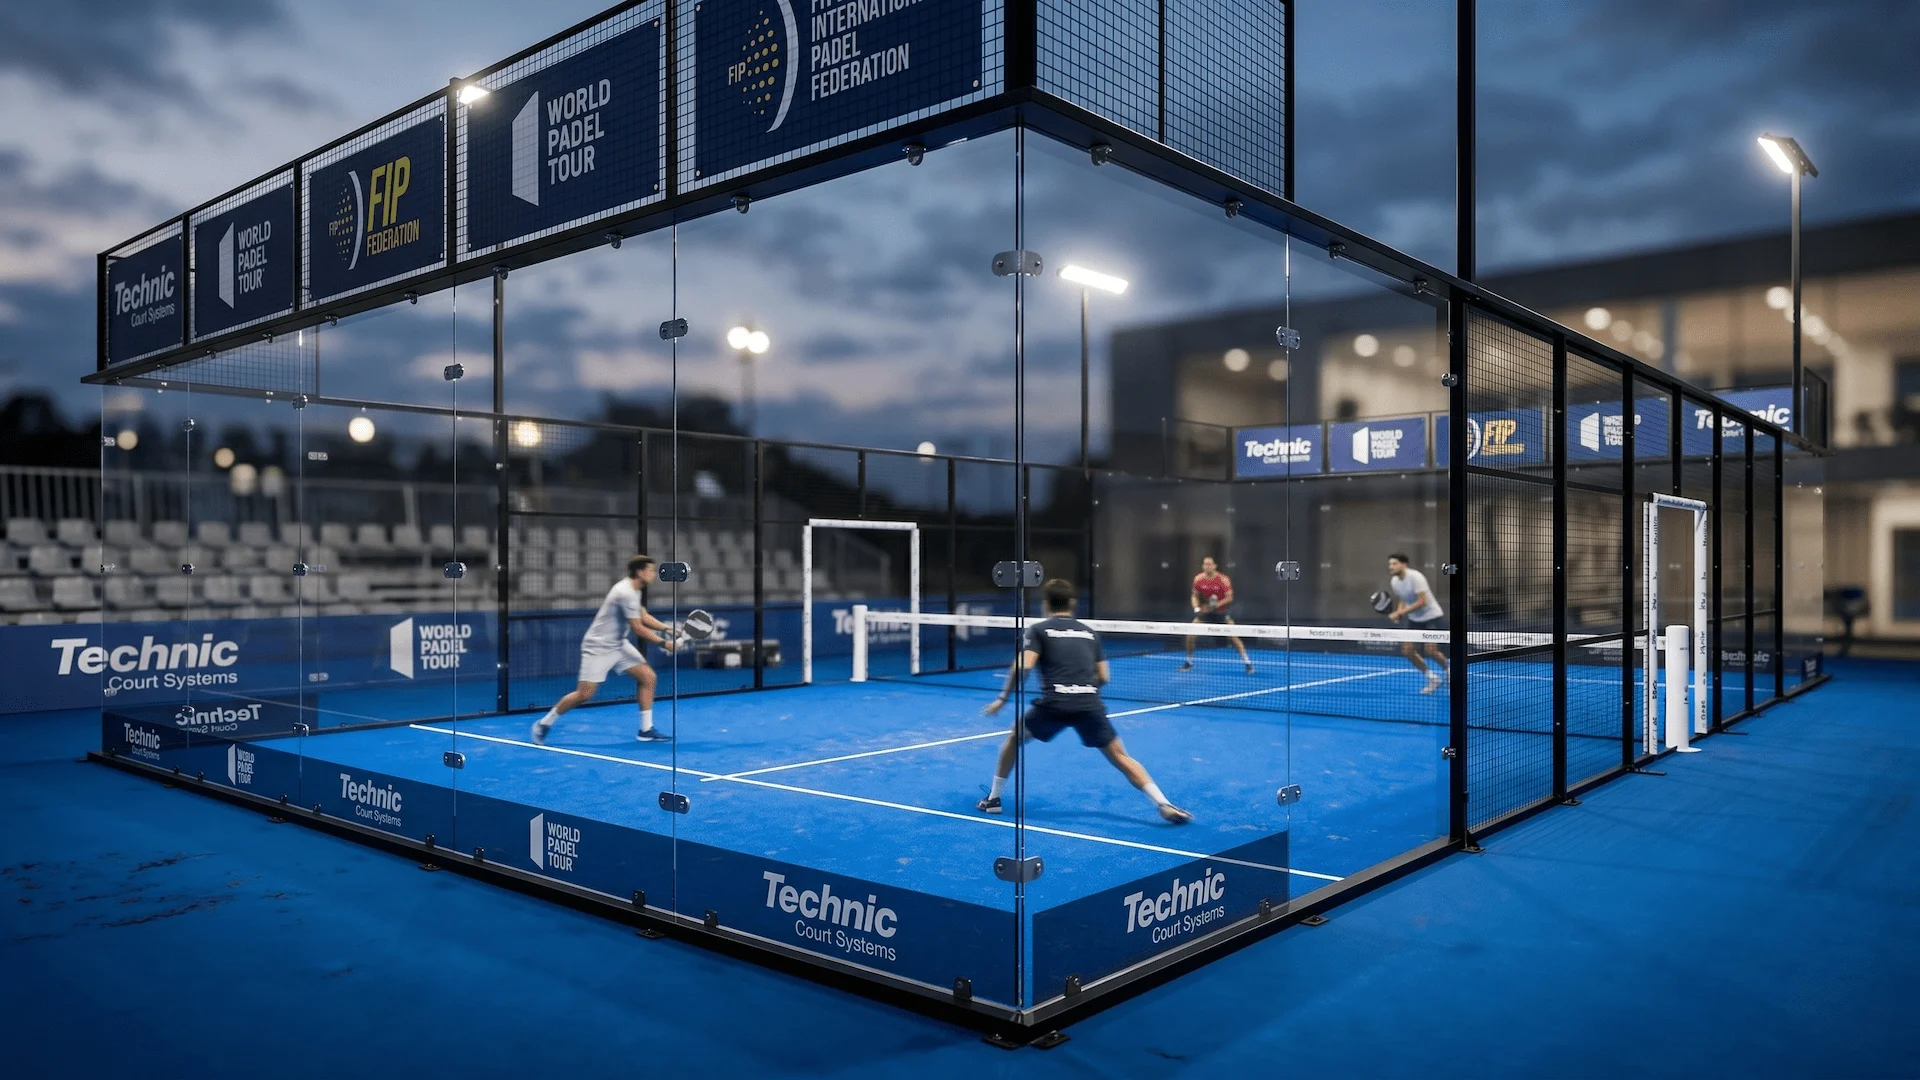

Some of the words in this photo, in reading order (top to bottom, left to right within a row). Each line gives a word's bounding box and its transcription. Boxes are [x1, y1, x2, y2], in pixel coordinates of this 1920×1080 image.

[811, 31, 861, 72] PADEL
[728, 62, 746, 86] FIP
[811, 43, 910, 101] FEDERATION
[547, 79, 611, 126] WORLD
[548, 112, 605, 156] PADEL
[547, 145, 595, 185] TOUR
[367, 155, 411, 232] FIP
[237, 220, 271, 250] WORLD
[328, 221, 339, 237] FIP
[366, 219, 420, 257] FEDERATION
[238, 245, 268, 273] PADEL
[115, 265, 175, 315] Technic
[237, 269, 264, 294] TOUR
[131, 307, 147, 327] Court
[149, 303, 175, 325] Systems
[1245, 437, 1312, 458] Technic
[419, 624, 472, 640] WORLD
[51, 633, 239, 676] Technic
[421, 639, 467, 655] PADEL
[420, 654, 460, 670] TOUR
[108, 675, 159, 691] Court
[163, 672, 238, 690] Systems
[124, 723, 161, 749] Technic
[237, 748, 255, 764] WORLD
[238, 772, 251, 784] TOUR
[340, 773, 402, 812] Technic
[355, 805, 373, 819] Court
[374, 810, 401, 827] Systems
[547, 822, 580, 843] WORLD
[548, 836, 578, 858] PADEL
[547, 851, 572, 872] TOUR
[763, 871, 898, 938] Technic
[1123, 867, 1225, 933] Technic
[1152, 920, 1181, 944] Court
[1183, 905, 1225, 933] Systems
[795, 919, 832, 944] Court
[836, 930, 897, 961] Systems
